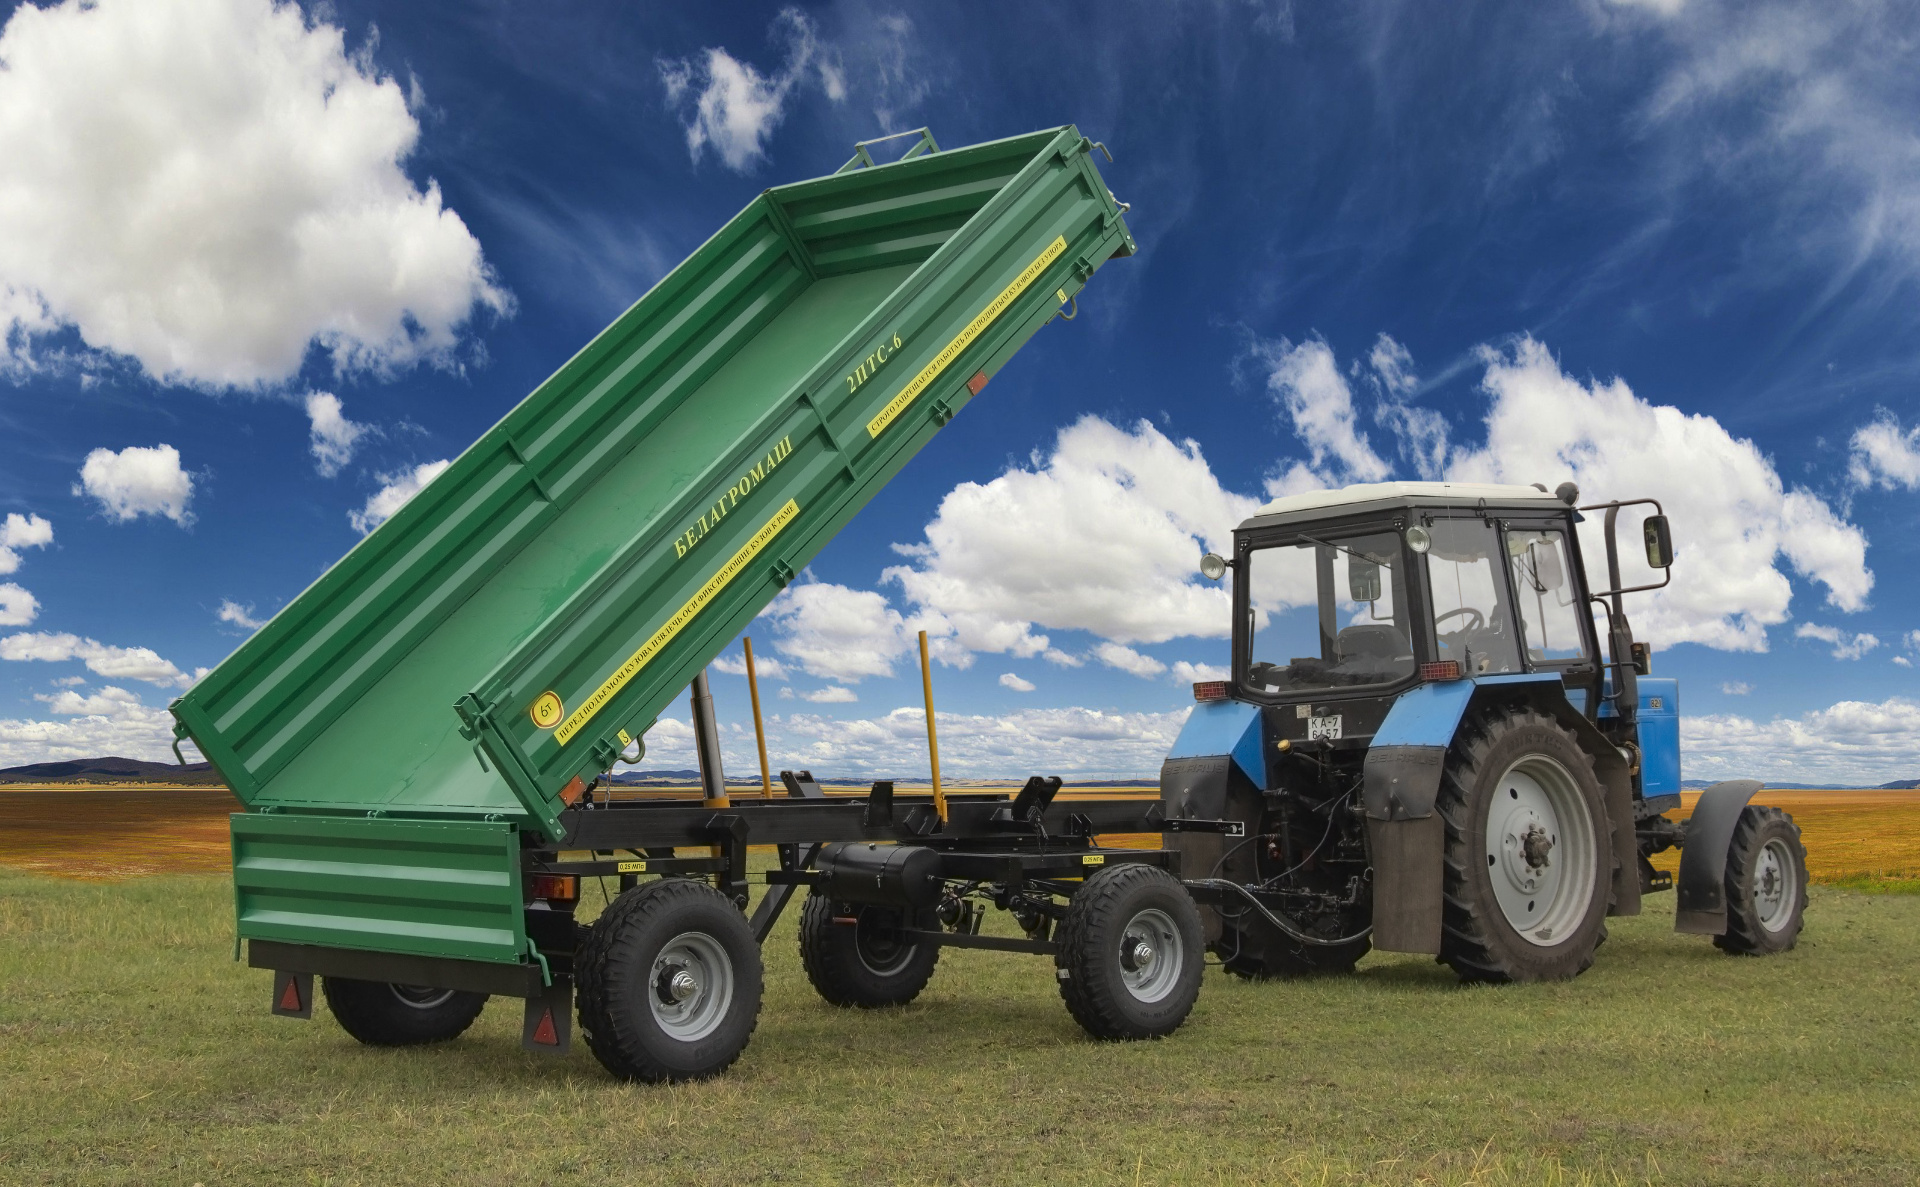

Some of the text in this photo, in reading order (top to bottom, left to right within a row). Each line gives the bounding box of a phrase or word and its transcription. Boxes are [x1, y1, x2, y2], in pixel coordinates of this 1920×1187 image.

[846, 331, 902, 394] 2ПТС-6
[871, 242, 1063, 431] СТРОГО ЗАПРЕЩАЕТСЯ РАБОТАТЬ ПОД ПОДНЯТЫМ КУЗОВОМ БЕЗ УПОРА
[673, 435, 793, 559] БЕЛАГРОМАШ
[559, 504, 795, 738] ПЕРЕД ПОДЪЕМОМ КУЗОВА ИЗВЛЕЧЬ ОСИ ФИКСИРУЮЩИЕ КУЗОВ К РАМЕ
[1165, 763, 1225, 776] BELARUS
[1368, 753, 1440, 766] BELARUS
